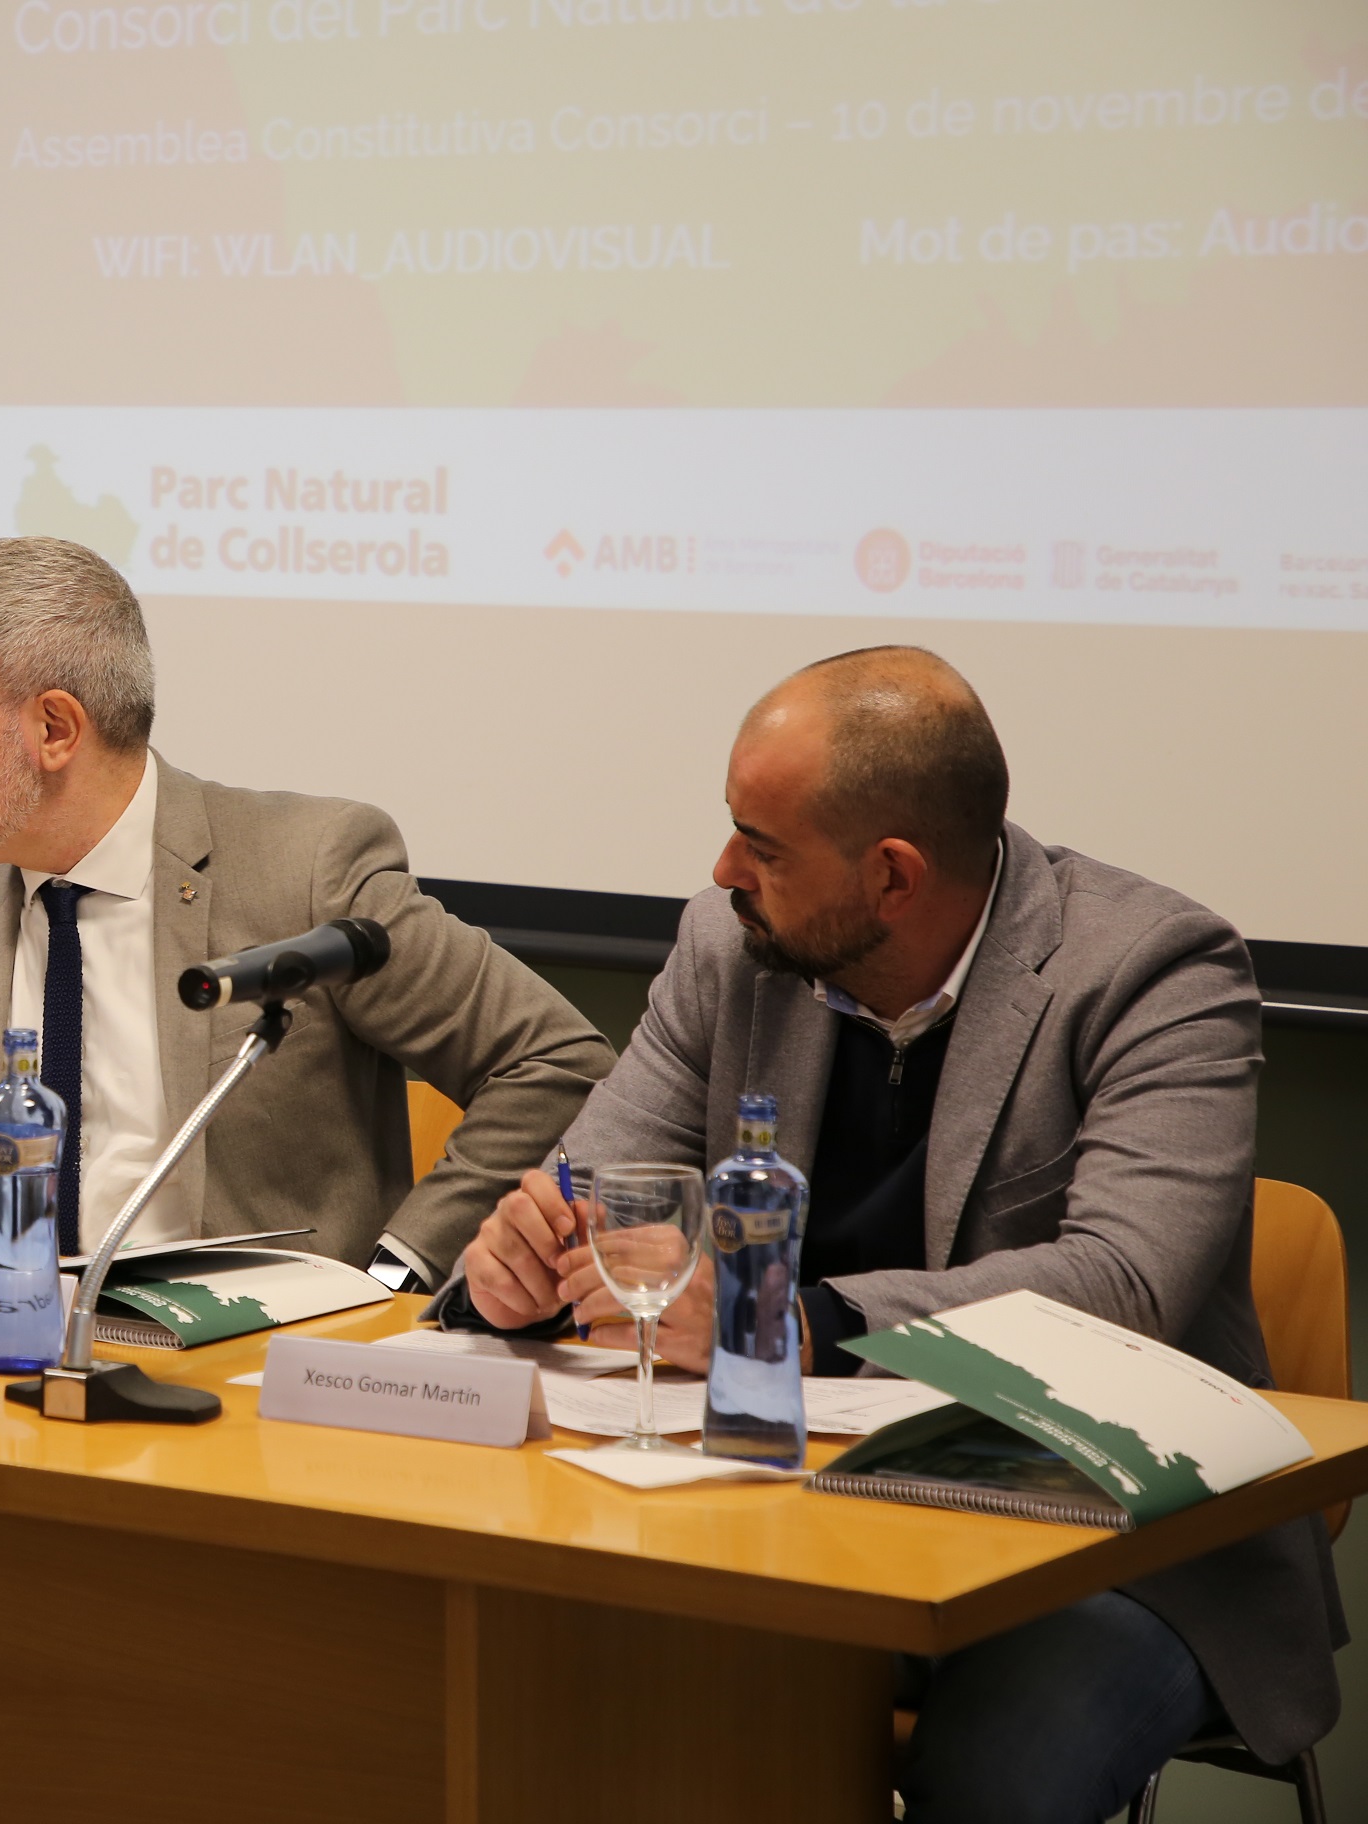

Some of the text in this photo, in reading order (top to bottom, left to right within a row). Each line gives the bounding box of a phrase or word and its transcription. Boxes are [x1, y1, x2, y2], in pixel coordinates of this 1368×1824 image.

[14, 0, 249, 54] Consorci
[269, 0, 360, 40] del
[11, 118, 250, 171] Assemblea
[263, 106, 534, 163] Constitutiva
[550, 97, 770, 152] Consorci
[831, 101, 885, 143] 10
[907, 86, 974, 138] de
[992, 75, 1291, 135] novembre
[92, 221, 731, 281] WIFI: WLAN_AUDIOVISUAL
[860, 216, 964, 266] Mot
[981, 211, 1052, 262] de
[1066, 219, 1182, 273] pas:
[149, 465, 448, 515] Parc Natural
[149, 523, 450, 577] de Collserola
[592, 534, 681, 574] AMB
[304, 1368, 481, 1406] Xesco Gomar Martín
